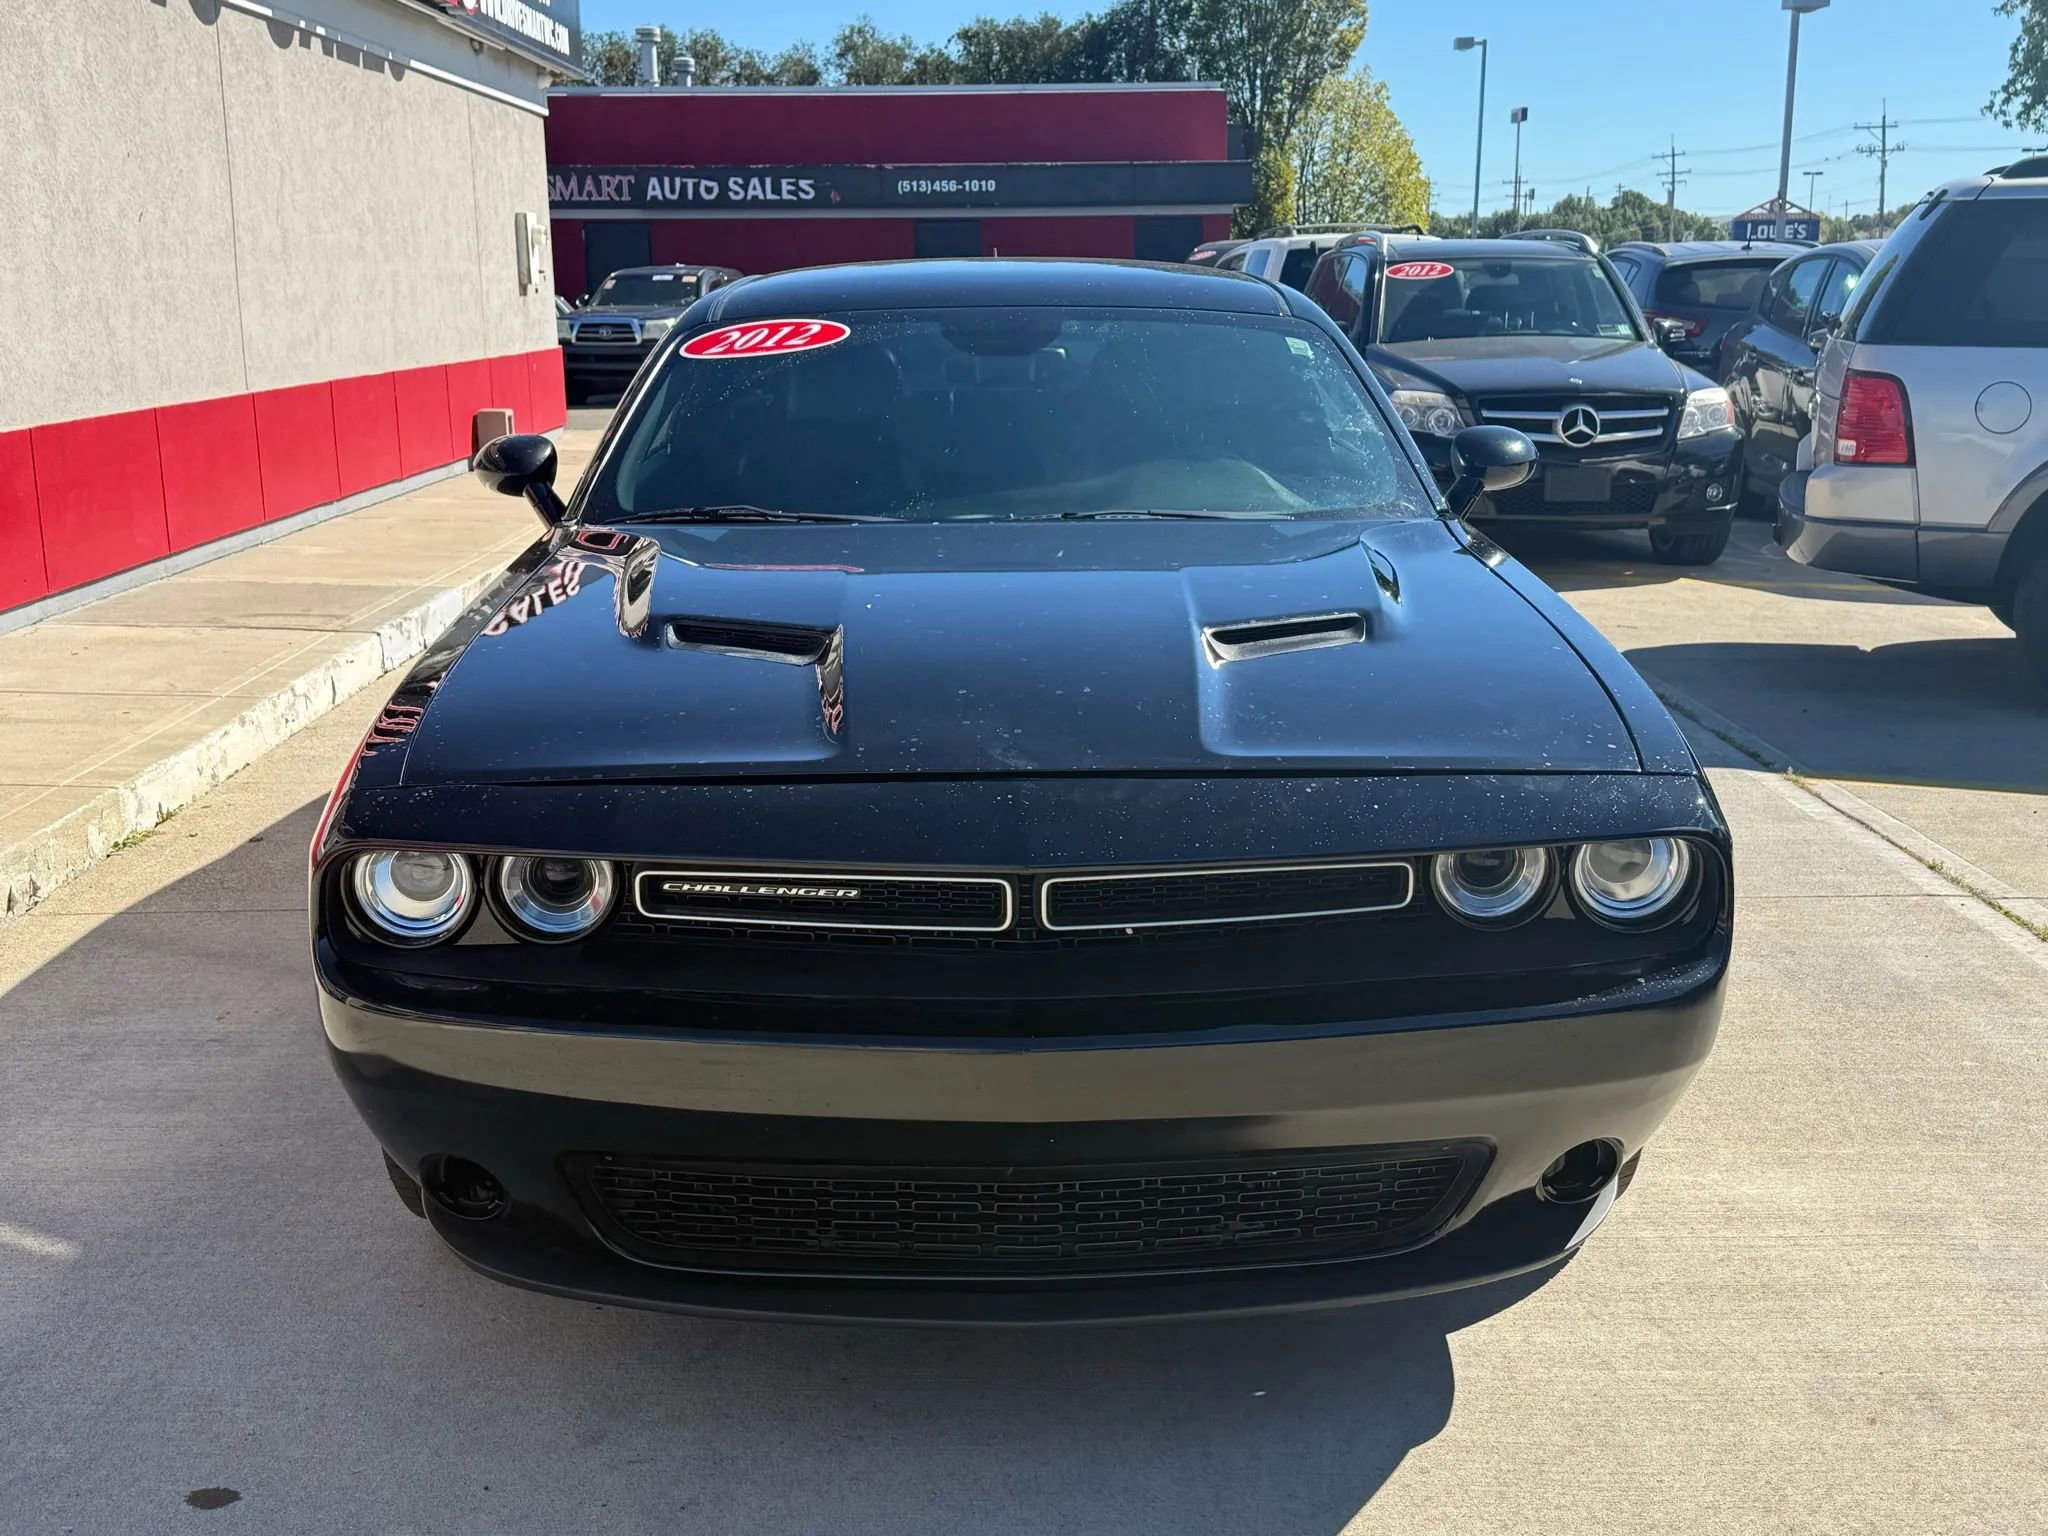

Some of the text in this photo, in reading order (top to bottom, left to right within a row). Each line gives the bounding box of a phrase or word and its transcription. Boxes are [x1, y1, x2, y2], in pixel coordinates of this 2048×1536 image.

[646, 176, 720, 201] AUTO
[727, 176, 816, 201] SALES
[897, 179, 997, 195] (513)456-1010
[1396, 264, 1443, 277] 2012
[701, 323, 823, 355] 2012
[662, 882, 859, 898] CHALLENGER
